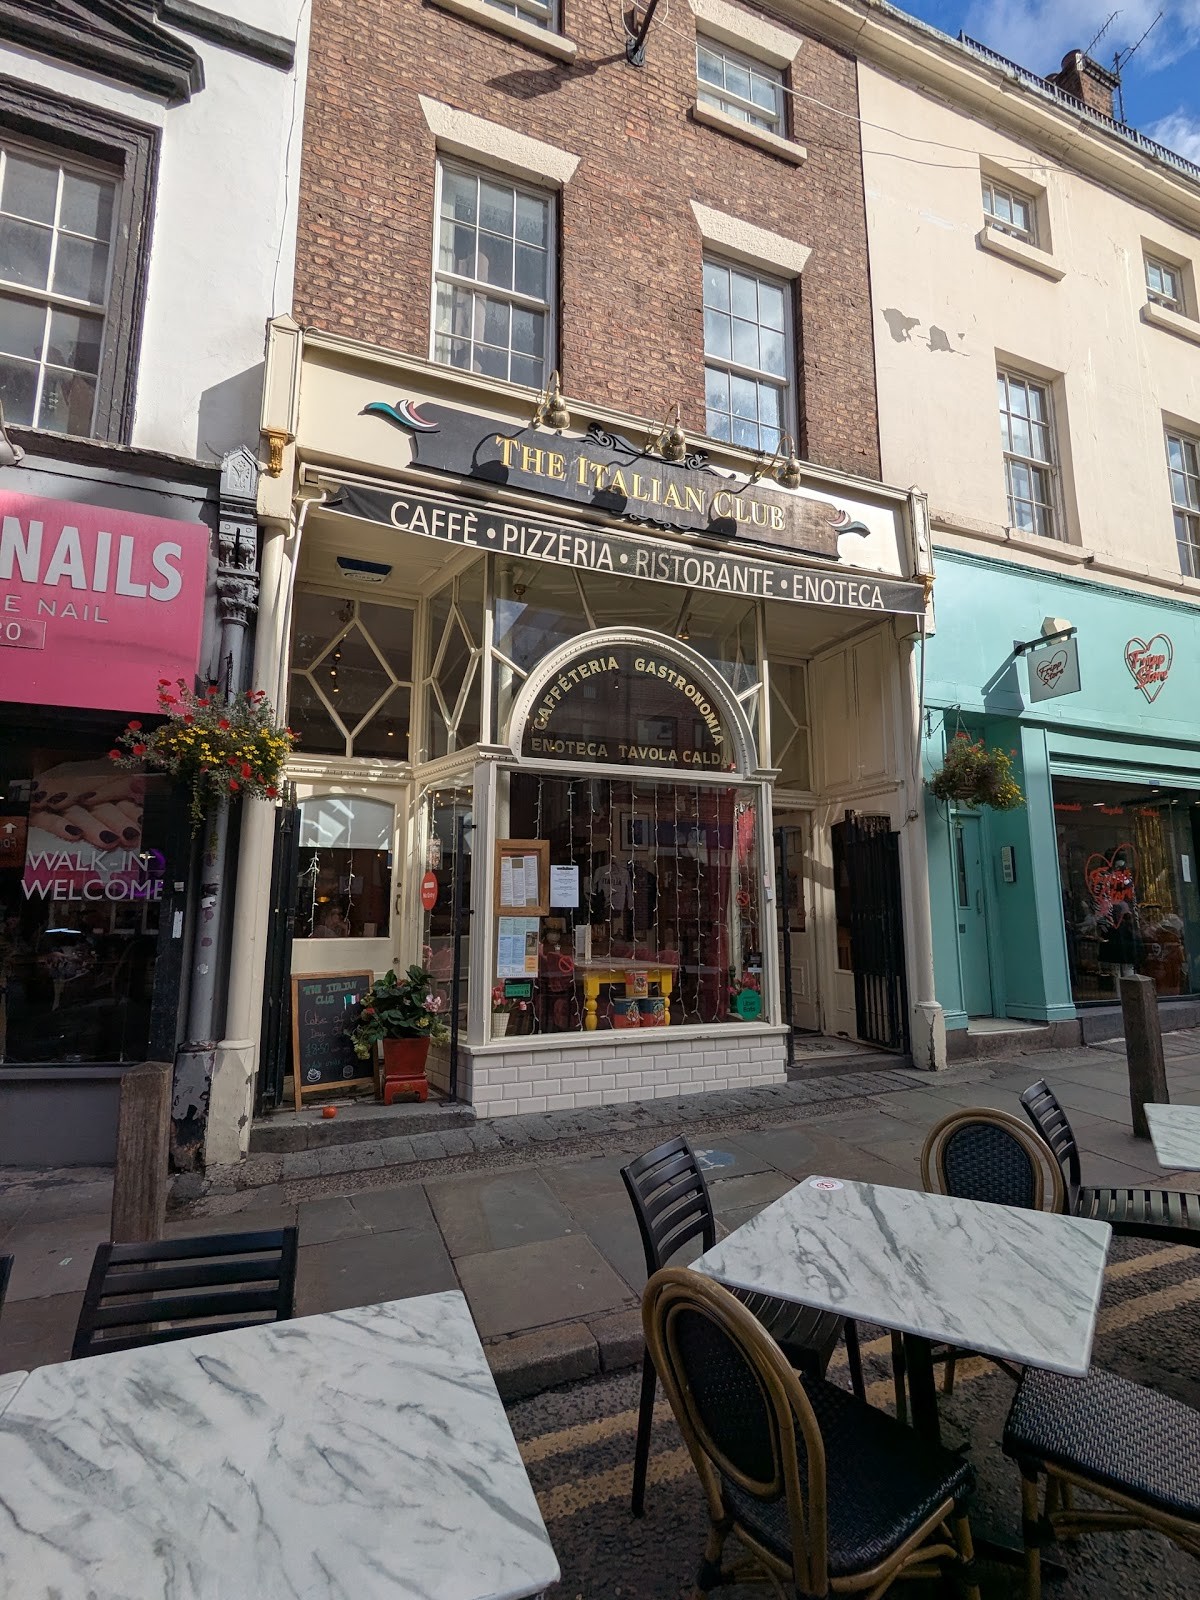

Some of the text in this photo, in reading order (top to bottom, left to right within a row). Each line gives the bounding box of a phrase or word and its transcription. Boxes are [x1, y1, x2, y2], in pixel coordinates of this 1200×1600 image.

[496, 434, 787, 532] THE ITALIAN CLUB
[0, 516, 183, 602] NAILS
[390, 501, 885, 610] CAFFÈ PIZZERIA RISTORANTE ENOTECA
[38, 598, 109, 623] NAIL
[634, 658, 725, 746] GASTRONOMIA
[530, 737, 728, 769] ENOTECA TAVOLA CALDA
[21, 879, 164, 900] WELCOME
[27, 850, 149, 872] WALK-IN
